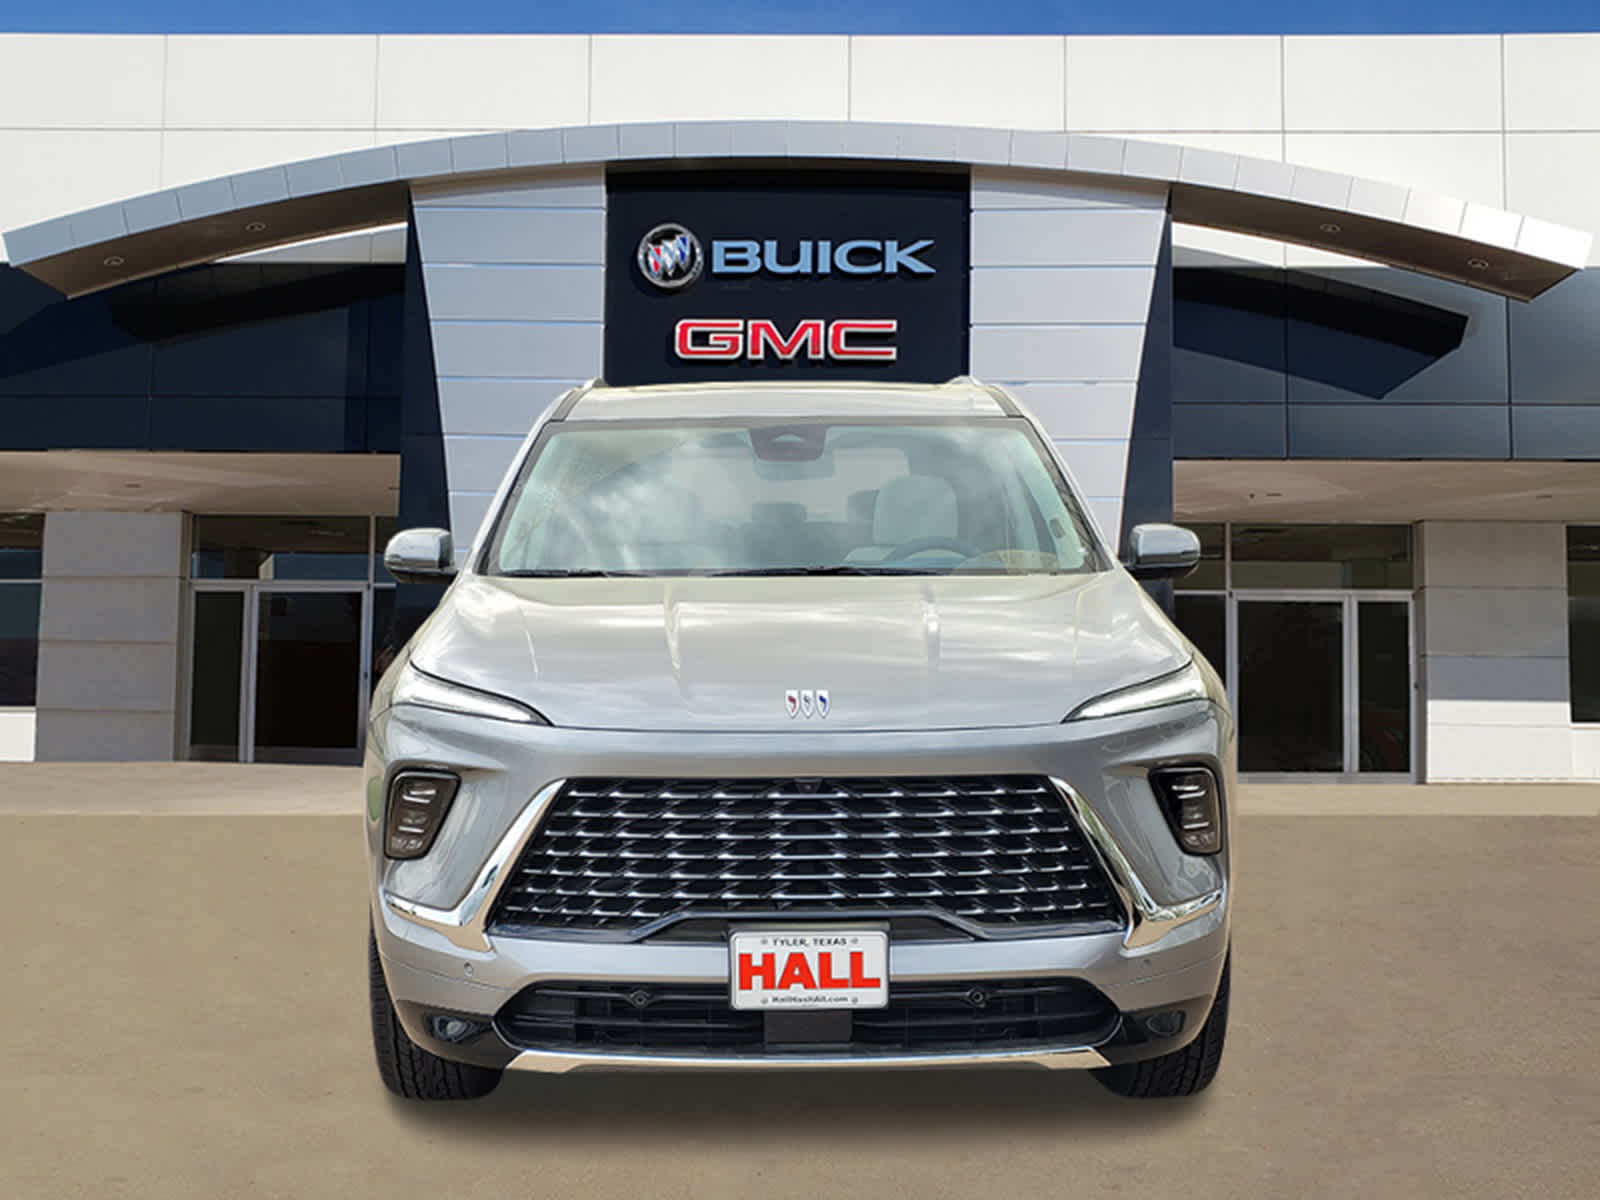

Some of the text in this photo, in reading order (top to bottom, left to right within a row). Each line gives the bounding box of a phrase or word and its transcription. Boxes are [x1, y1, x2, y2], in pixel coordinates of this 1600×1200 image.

[712, 240, 936, 274] BUICK
[675, 319, 897, 360] GMC
[773, 937, 847, 947] TYLER, TEXAS
[739, 952, 880, 990] HALL
